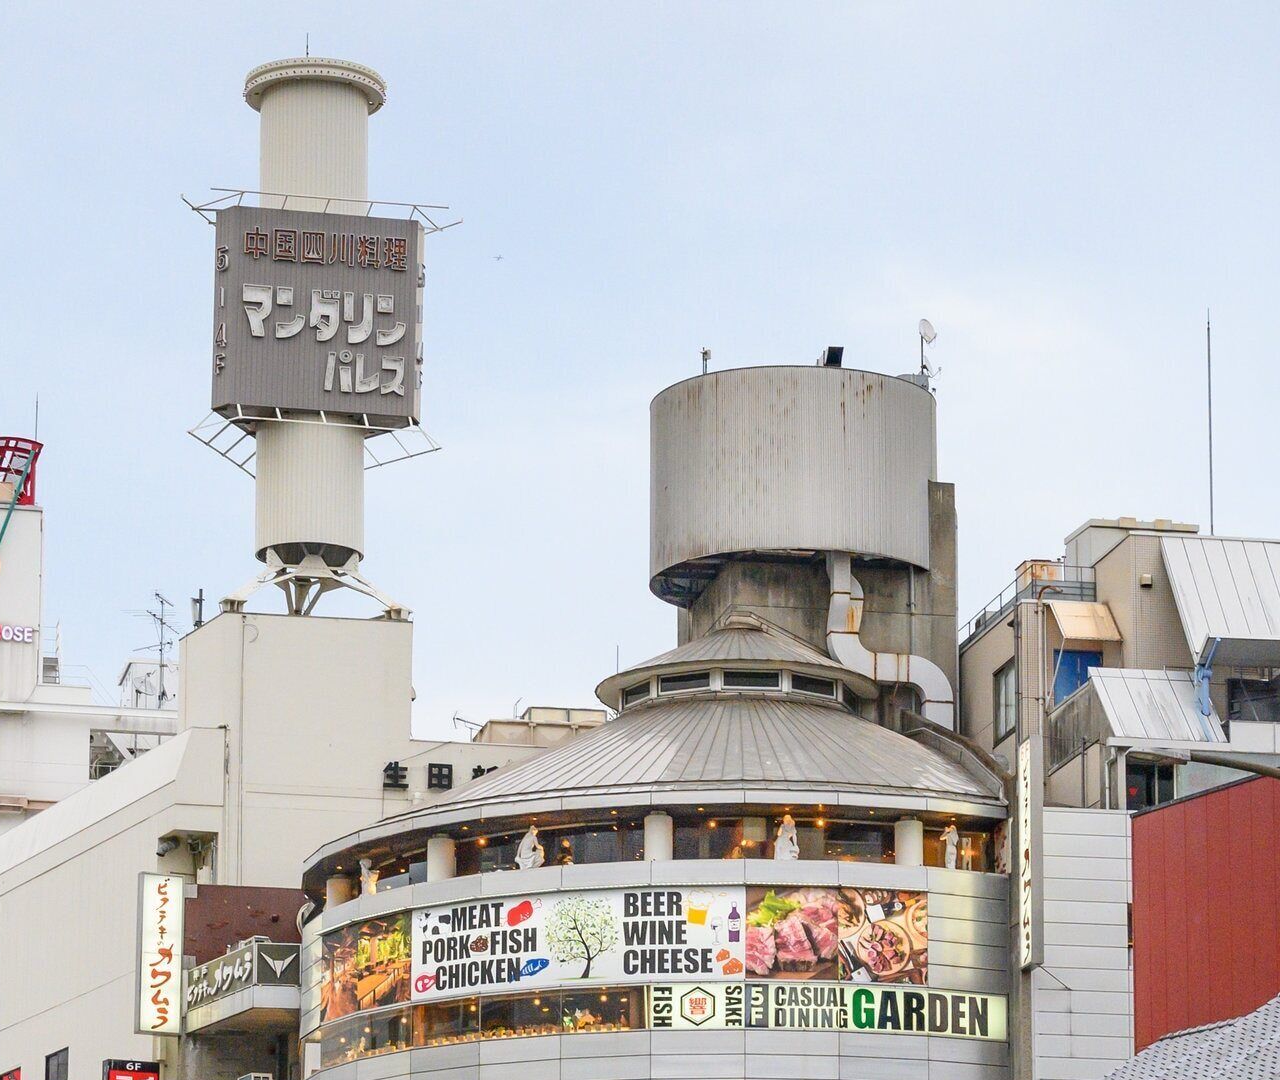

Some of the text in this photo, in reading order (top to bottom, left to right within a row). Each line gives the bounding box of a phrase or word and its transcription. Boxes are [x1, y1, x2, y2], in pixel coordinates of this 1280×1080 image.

[243, 226, 408, 271] 中国四川料理
[242, 283, 407, 347] マンダリン
[323, 349, 405, 397] パレス
[451, 902, 504, 931] MEAT
[623, 891, 682, 918] BEER
[421, 927, 537, 966] PORK FISH
[623, 919, 687, 947] WINE
[435, 957, 521, 992] CHICKEN
[623, 948, 712, 975] CHEESE
[149, 943, 175, 1030] カワムラ
[774, 986, 848, 1007] CASUAL
[653, 986, 673, 1028] FISH
[725, 985, 742, 1027] SAKE
[774, 1008, 848, 1029] DINING
[852, 987, 989, 1037] GARDEN
[125, 1061, 142, 1071] 6F
